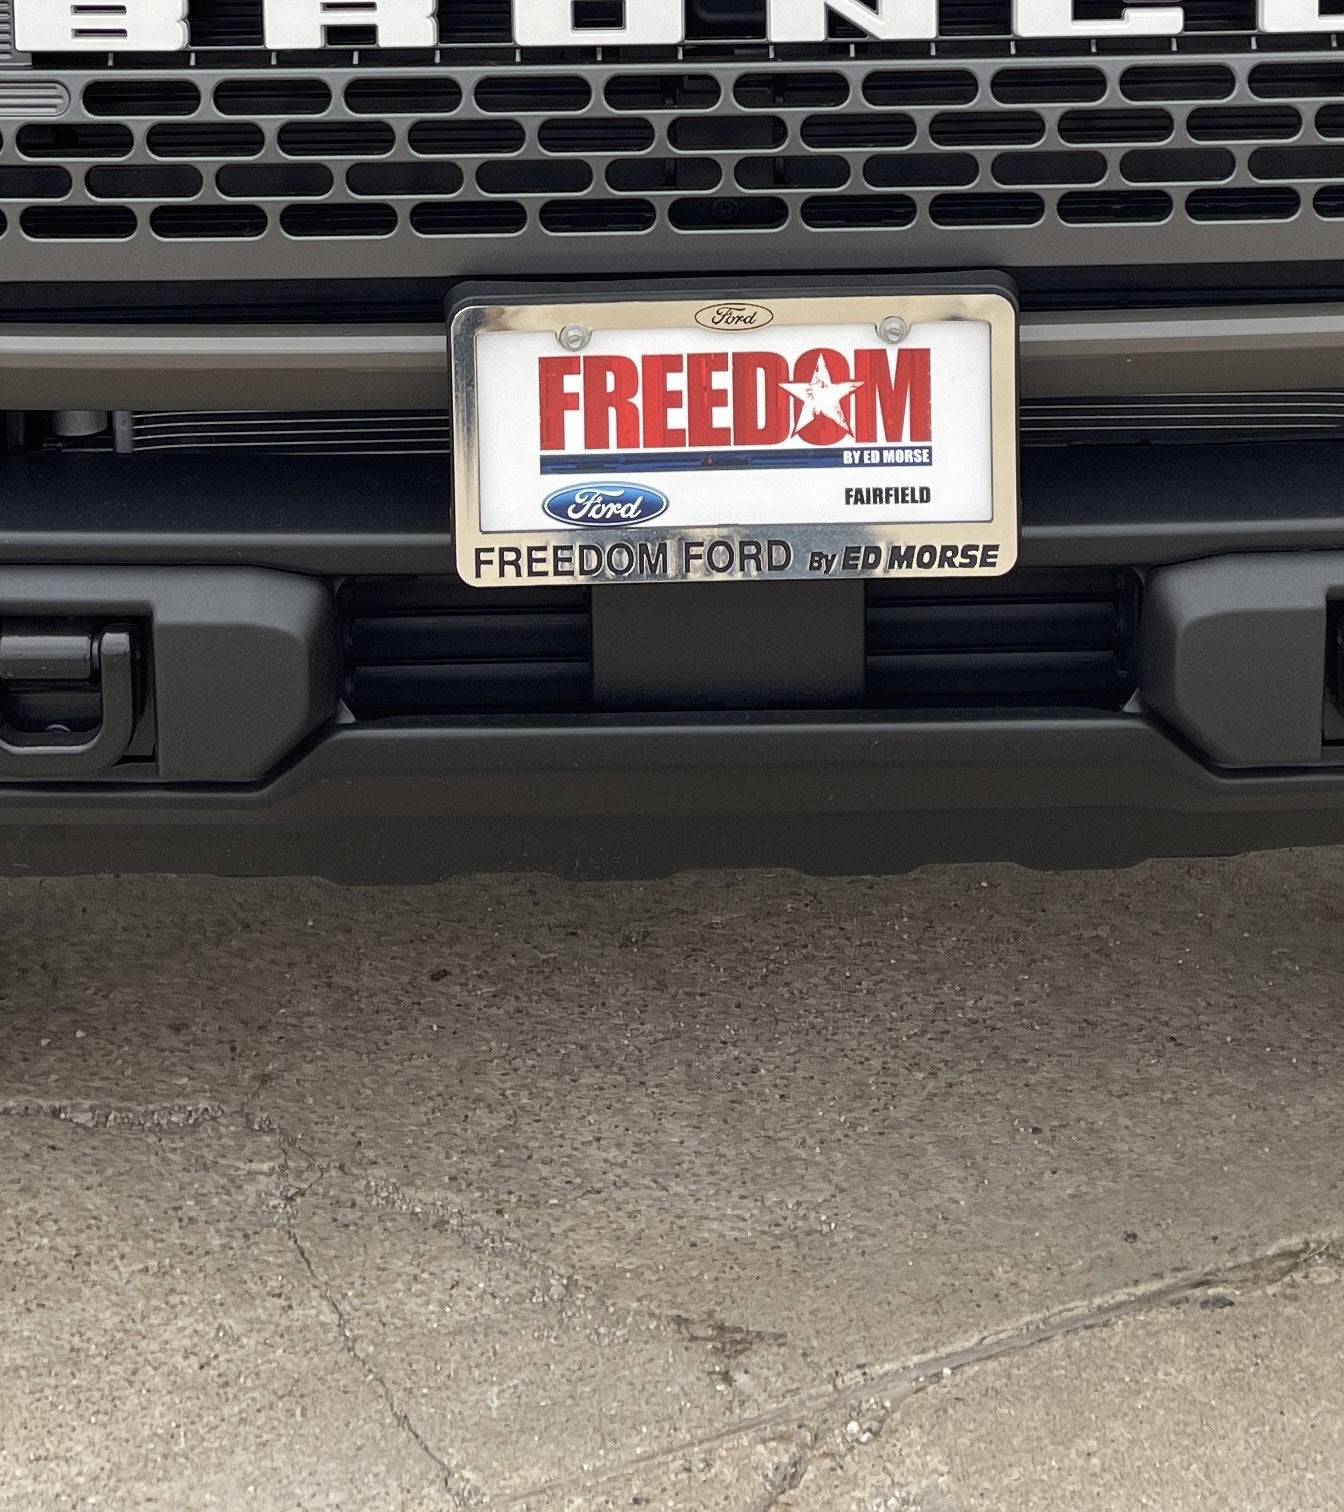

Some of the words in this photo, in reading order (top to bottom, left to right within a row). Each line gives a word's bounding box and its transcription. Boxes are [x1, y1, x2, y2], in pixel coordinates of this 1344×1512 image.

[709, 306, 759, 327] Ford
[538, 347, 932, 451] FREEDOM
[843, 449, 860, 465] BY
[863, 448, 881, 464] ED
[882, 448, 930, 464] MORSE
[566, 490, 644, 522] Ford
[844, 486, 931, 506] FAIRFIELD
[474, 541, 668, 579] FREEDOM
[684, 539, 793, 573] FORD
[808, 551, 837, 575] By
[841, 545, 882, 571] ED
[887, 543, 1000, 571] MORSE
